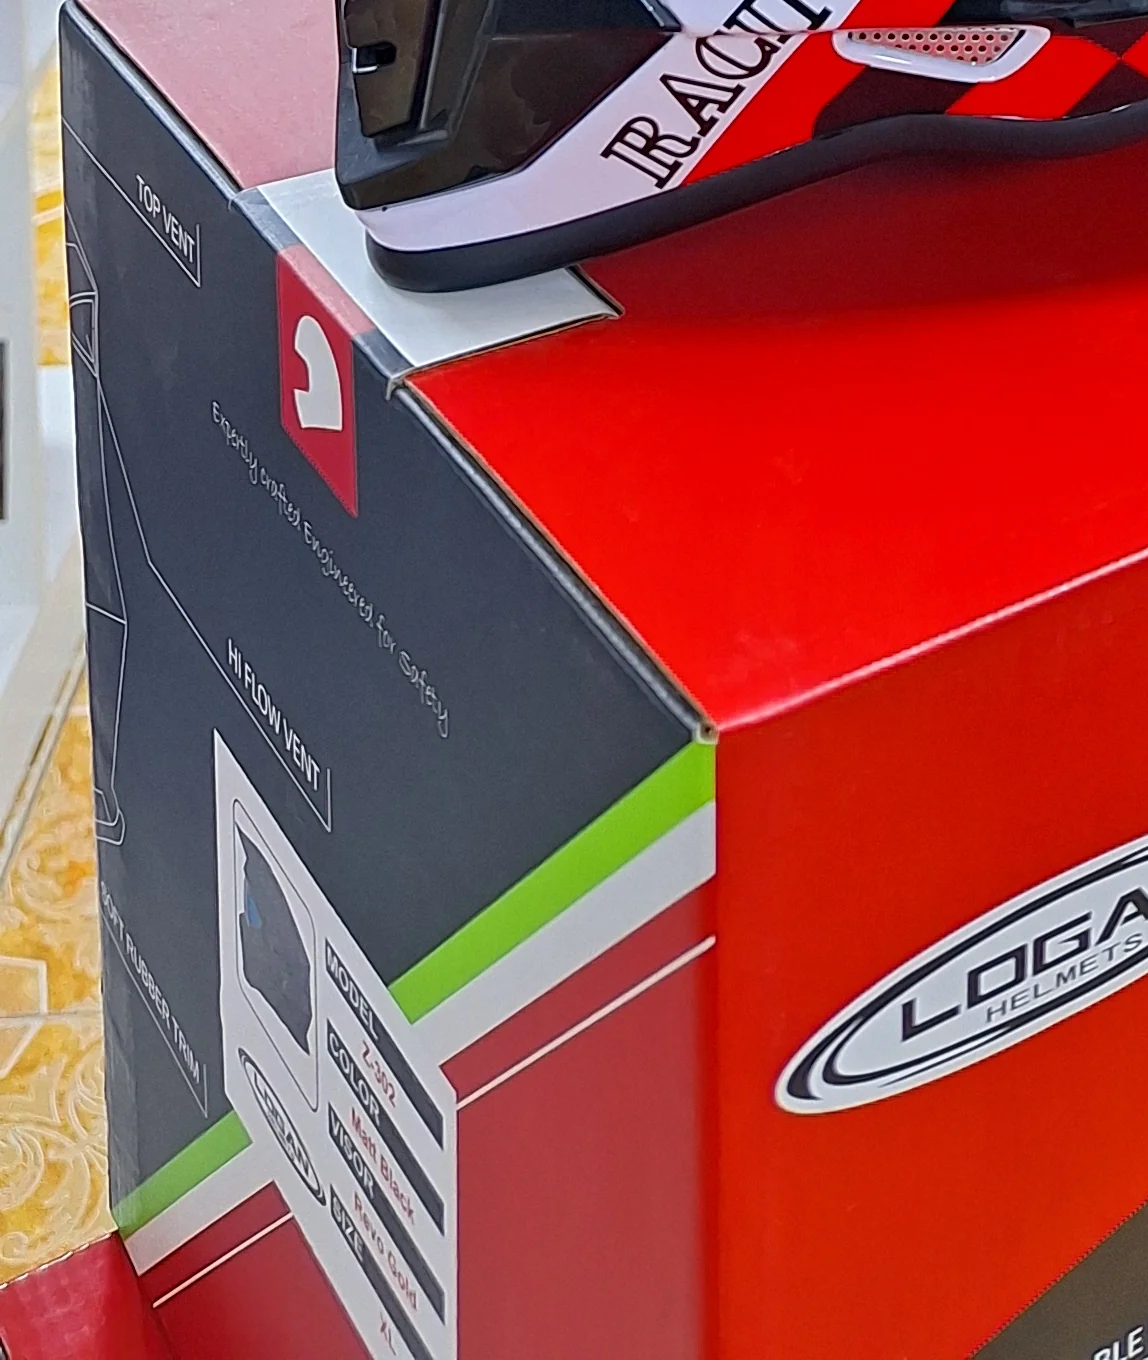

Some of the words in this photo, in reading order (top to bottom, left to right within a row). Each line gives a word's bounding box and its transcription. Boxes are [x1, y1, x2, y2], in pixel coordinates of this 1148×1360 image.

[136, 174, 161, 219] TOP
[162, 204, 195, 263] VENT
[212, 400, 258, 484] Expertly
[302, 521, 374, 629] Engineered
[376, 614, 396, 654] for
[398, 650, 449, 739] Safety
[228, 638, 241, 679] HI
[244, 662, 281, 735] FLOW
[282, 717, 321, 791] VENT
[100, 880, 125, 942] SOFT
[125, 932, 171, 1030] RUBBER
[171, 1015, 199, 1084] TRIM
[327, 944, 379, 1040] MODEL
[985, 932, 1143, 1025] HELMETS
[329, 1032, 381, 1127] COLOR
[361, 1041, 396, 1109] Z-302
[254, 1071, 311, 1179] LOGAN
[332, 1115, 376, 1201] VISOR
[351, 1106, 376, 1165] Matt
[380, 1155, 416, 1226] Black
[333, 1199, 366, 1261] SIZE
[355, 1191, 384, 1256] Revo
[387, 1251, 417, 1311] Gold
